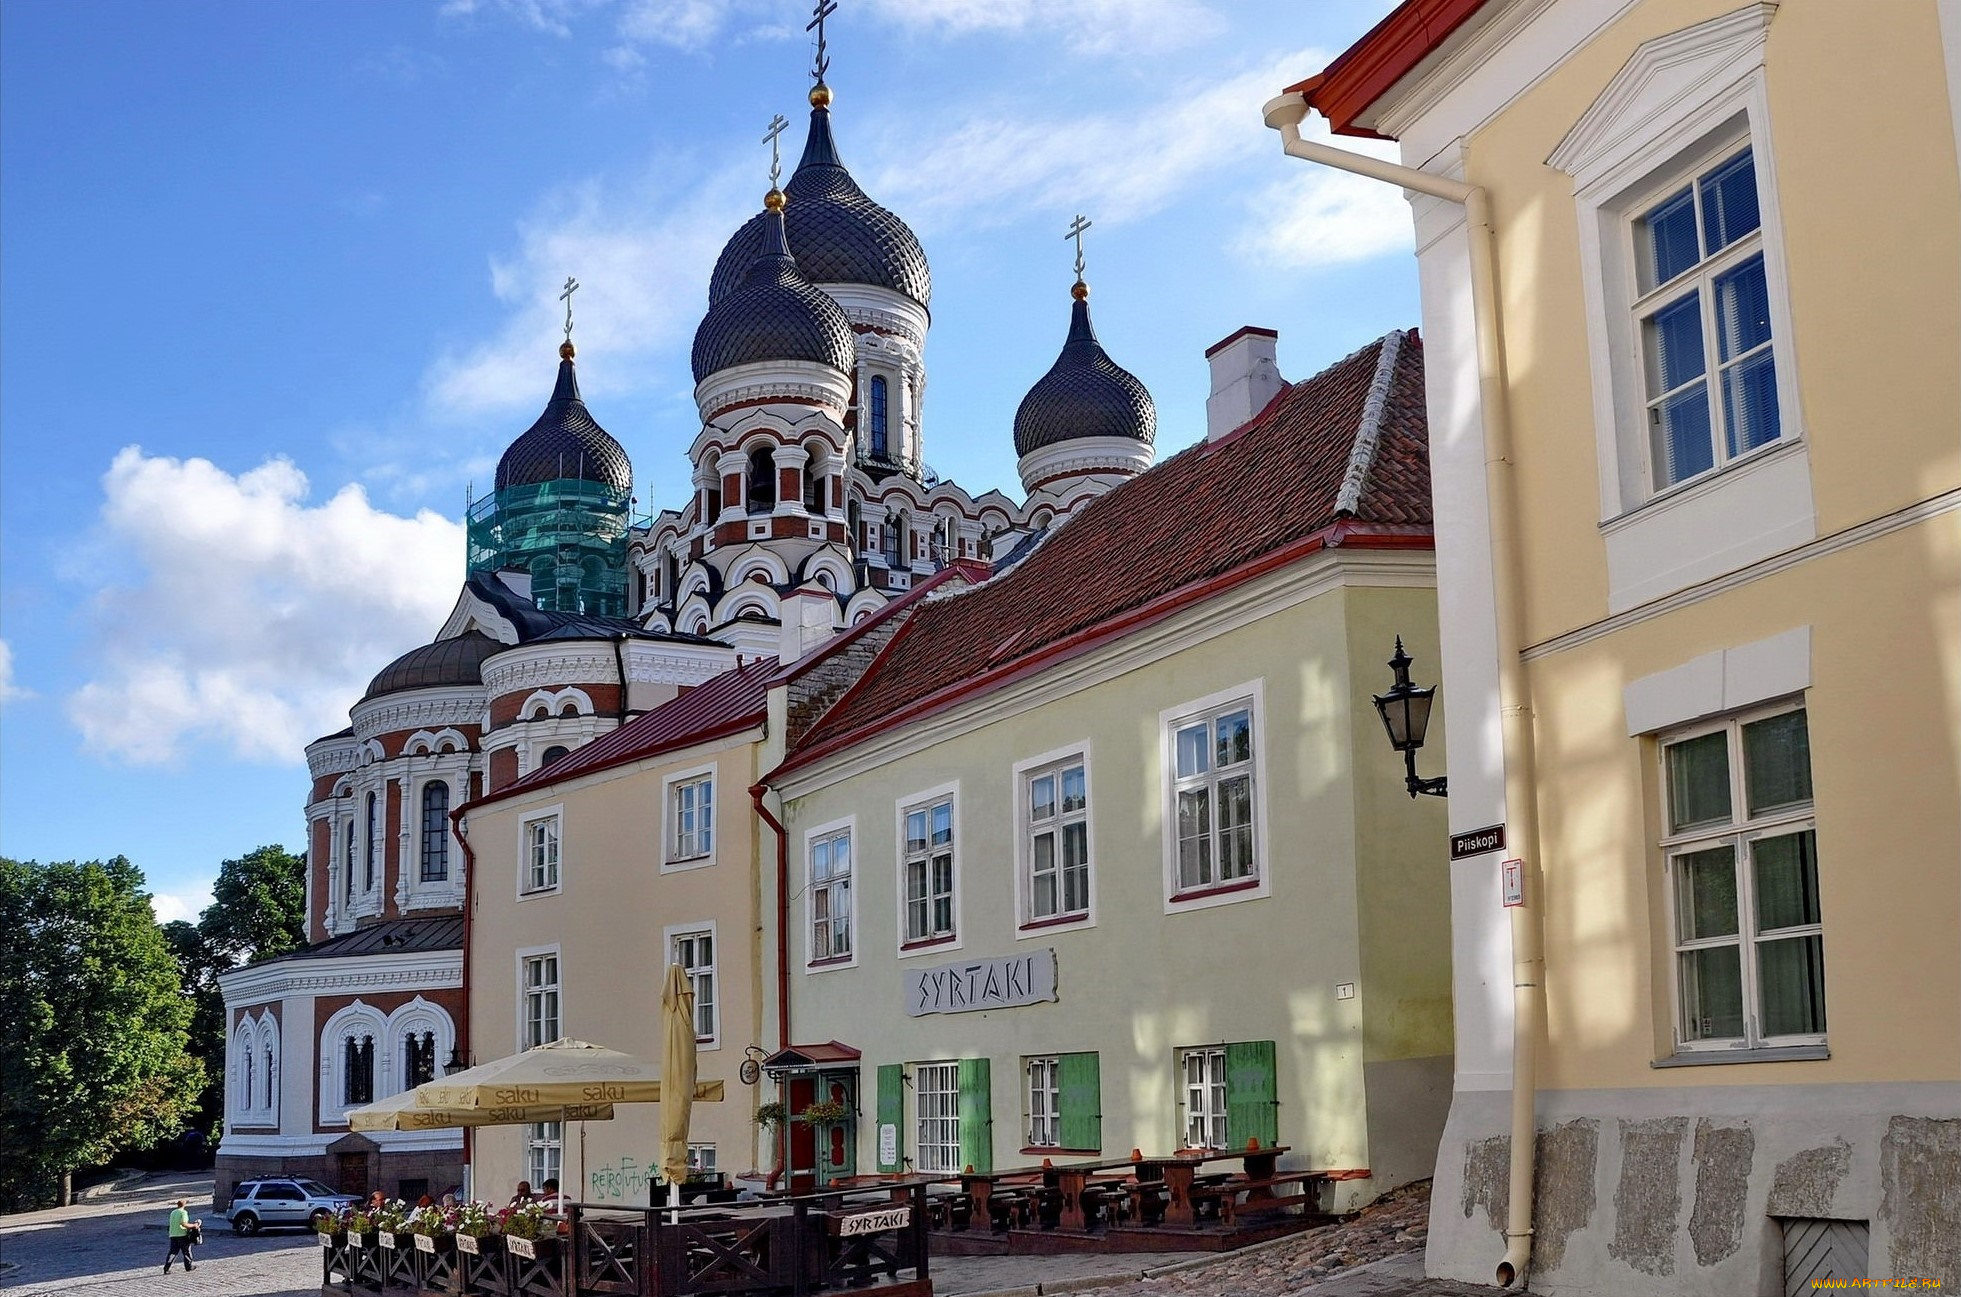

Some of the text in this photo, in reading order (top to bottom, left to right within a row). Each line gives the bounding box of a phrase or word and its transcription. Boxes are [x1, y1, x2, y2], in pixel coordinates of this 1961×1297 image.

[1457, 832, 1498, 852] Piiskopi
[918, 956, 1035, 1012] SYRTAKI
[495, 1085, 540, 1105] saku
[582, 1082, 625, 1101] saku
[413, 1110, 452, 1126] saku
[488, 1107, 526, 1122] saku
[849, 1212, 904, 1233] SYRTAKI
